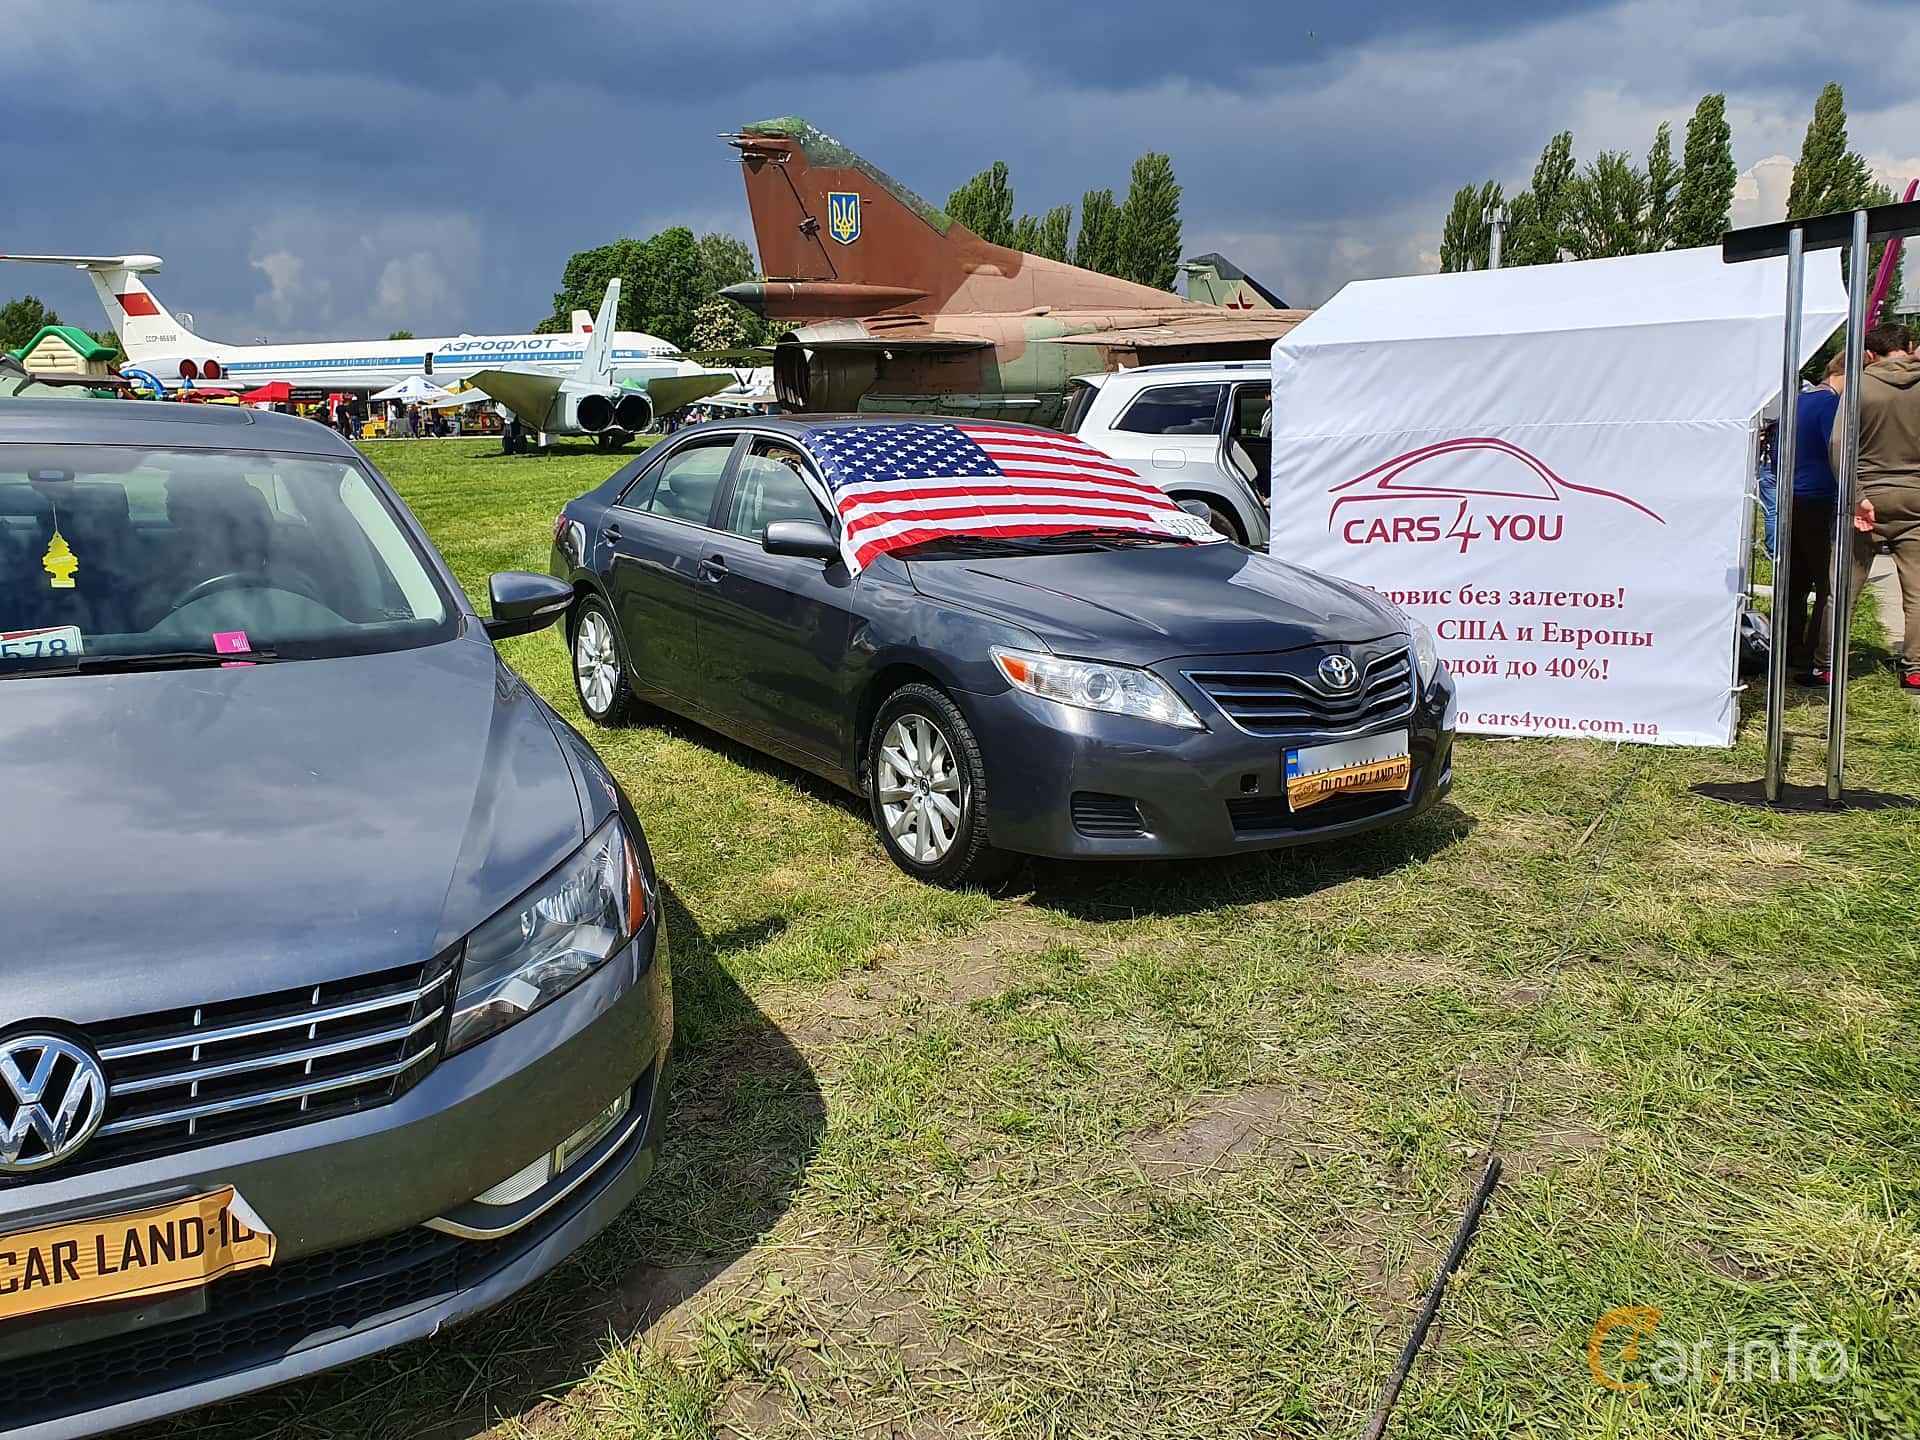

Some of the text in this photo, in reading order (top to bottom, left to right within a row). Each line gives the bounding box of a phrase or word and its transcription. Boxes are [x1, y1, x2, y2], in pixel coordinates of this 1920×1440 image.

[439, 339, 559, 352] АЭРОФЛОТ
[1458, 583, 1501, 606] без
[1508, 588, 1625, 609] залетов!
[1437, 619, 1654, 651] США и Европы
[1505, 660, 1537, 679] до
[1545, 657, 1609, 681] 40%!
[1477, 711, 1660, 736] cars4you.com.ua
